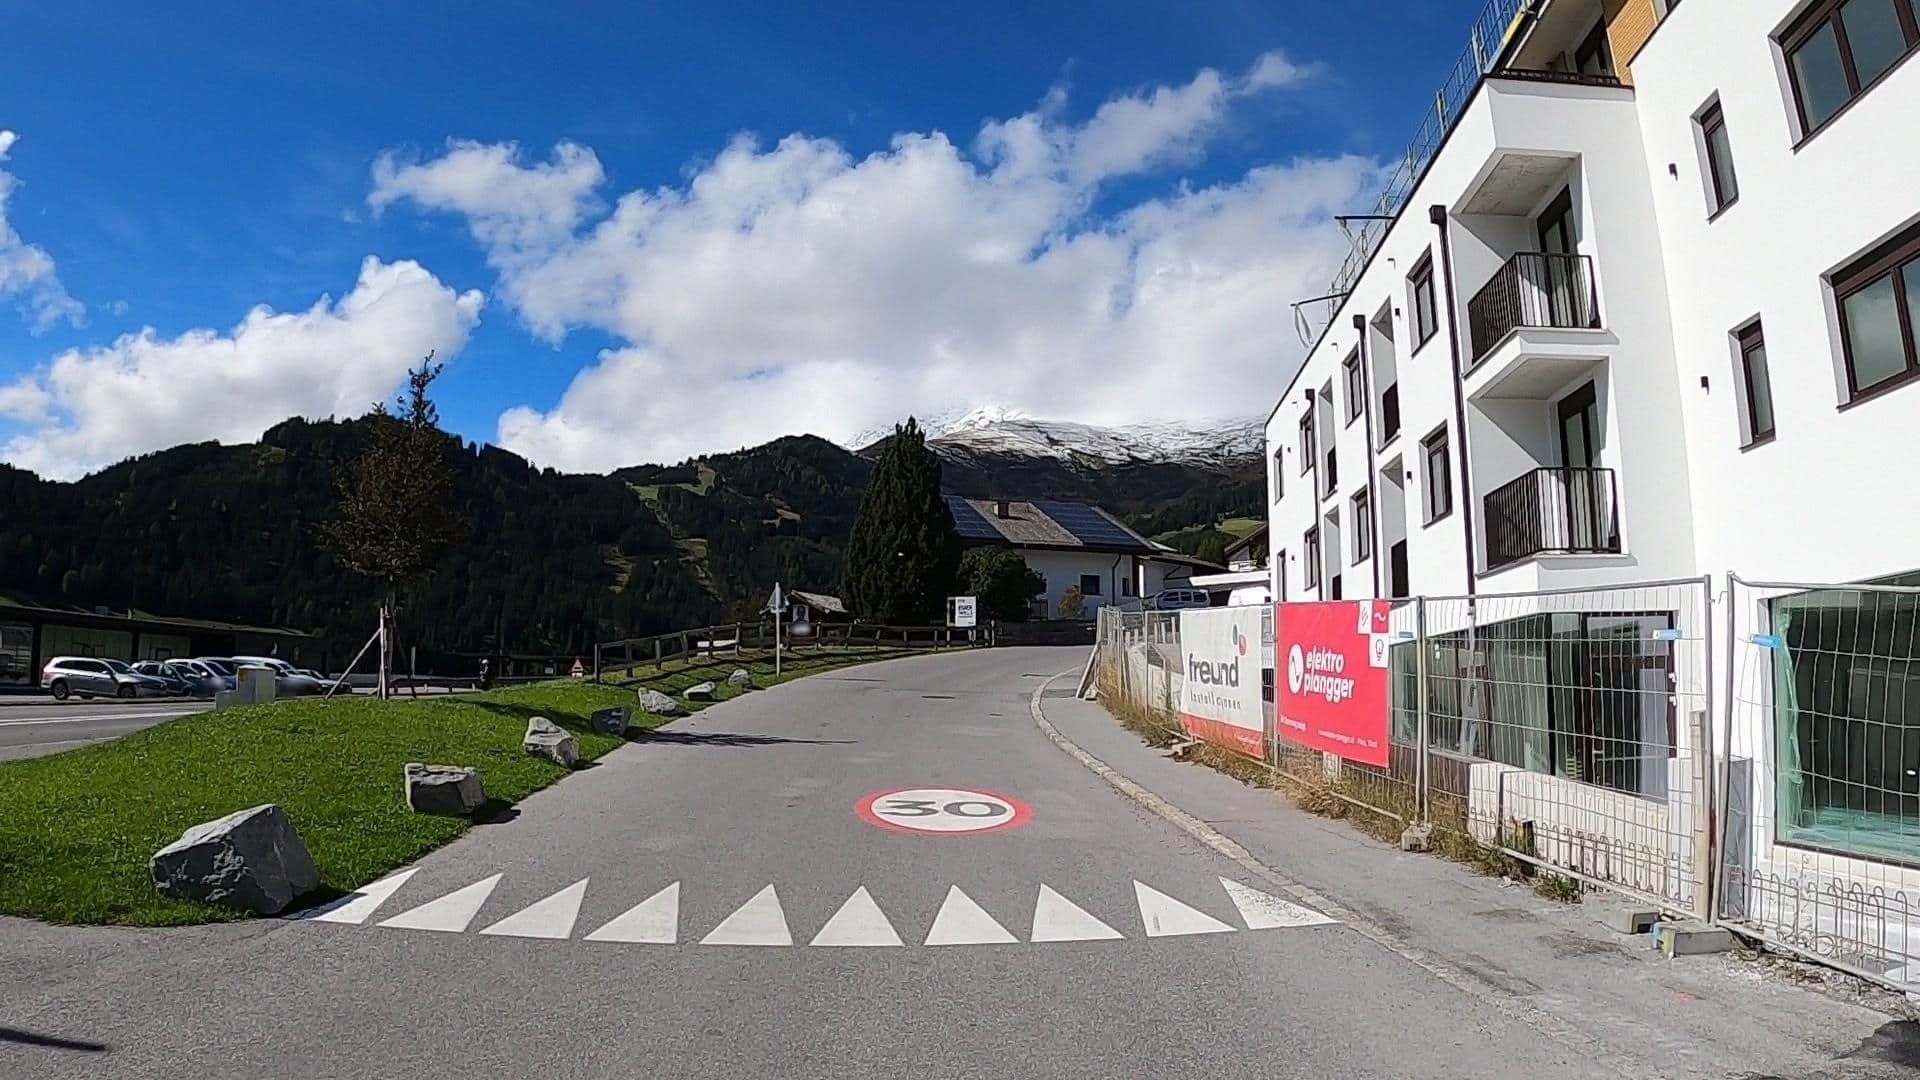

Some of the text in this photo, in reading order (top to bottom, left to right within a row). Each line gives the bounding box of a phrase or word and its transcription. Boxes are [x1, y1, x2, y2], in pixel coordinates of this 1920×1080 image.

[1189, 653, 1239, 687] freund
[1306, 645, 1344, 673] elektro
[1303, 672, 1355, 703] plangger
[879, 800, 1008, 818] 30
